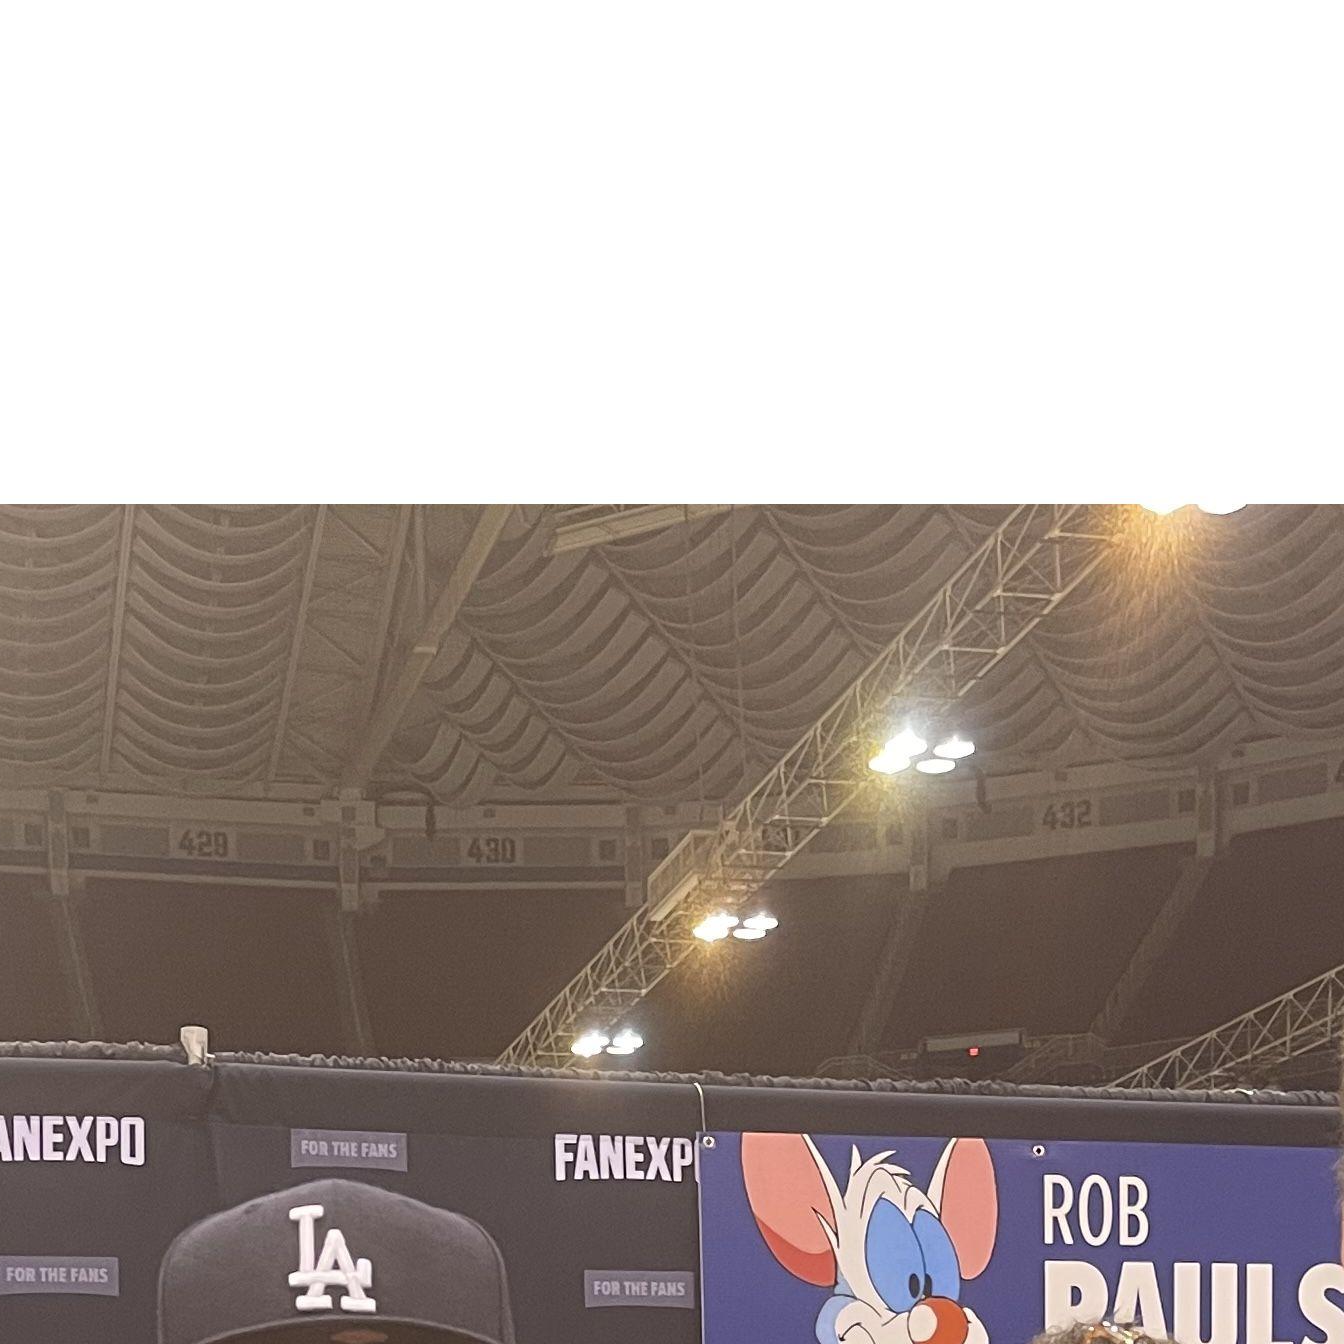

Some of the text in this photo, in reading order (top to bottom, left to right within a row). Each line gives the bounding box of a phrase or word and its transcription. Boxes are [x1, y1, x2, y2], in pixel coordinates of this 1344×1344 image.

[1042, 800, 1093, 830] 432
[178, 829, 229, 858] 429
[467, 836, 517, 864] 430
[300, 1140, 398, 1159] FOR THE FANS
[555, 1134, 699, 1182] FANEXP
[1043, 1174, 1149, 1246] ROB
[288, 1204, 376, 1312] LA
[6, 1267, 109, 1284] FOR THE FANS
[593, 1280, 686, 1297] FOR THE FANS
